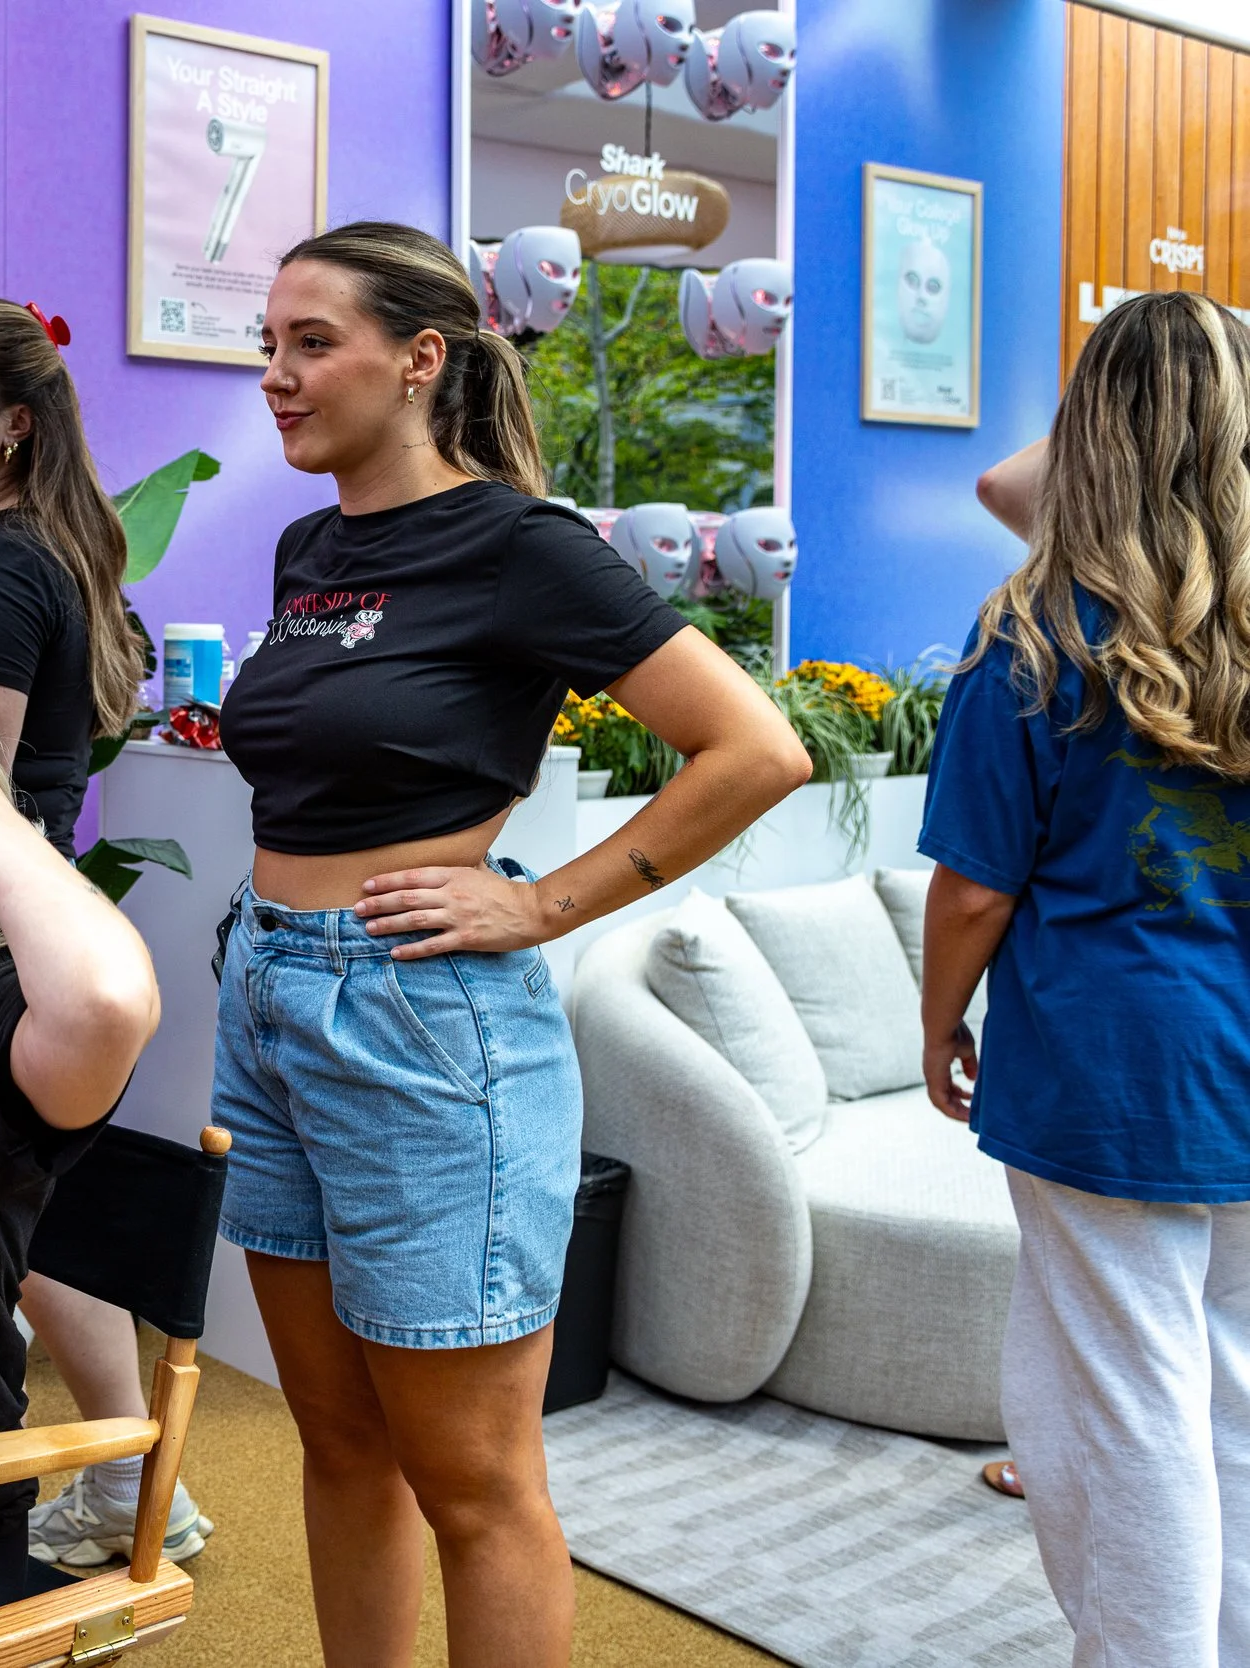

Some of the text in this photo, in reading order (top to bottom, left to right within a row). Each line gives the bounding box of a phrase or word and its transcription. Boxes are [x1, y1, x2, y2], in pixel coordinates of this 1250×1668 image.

[166, 55, 298, 104] Your Straight
[196, 89, 268, 123] A Style
[600, 143, 667, 180] Shark
[565, 168, 699, 222] CryoGlow
[285, 592, 392, 613] ERSITY OF
[270, 608, 349, 645] Wisconsin
